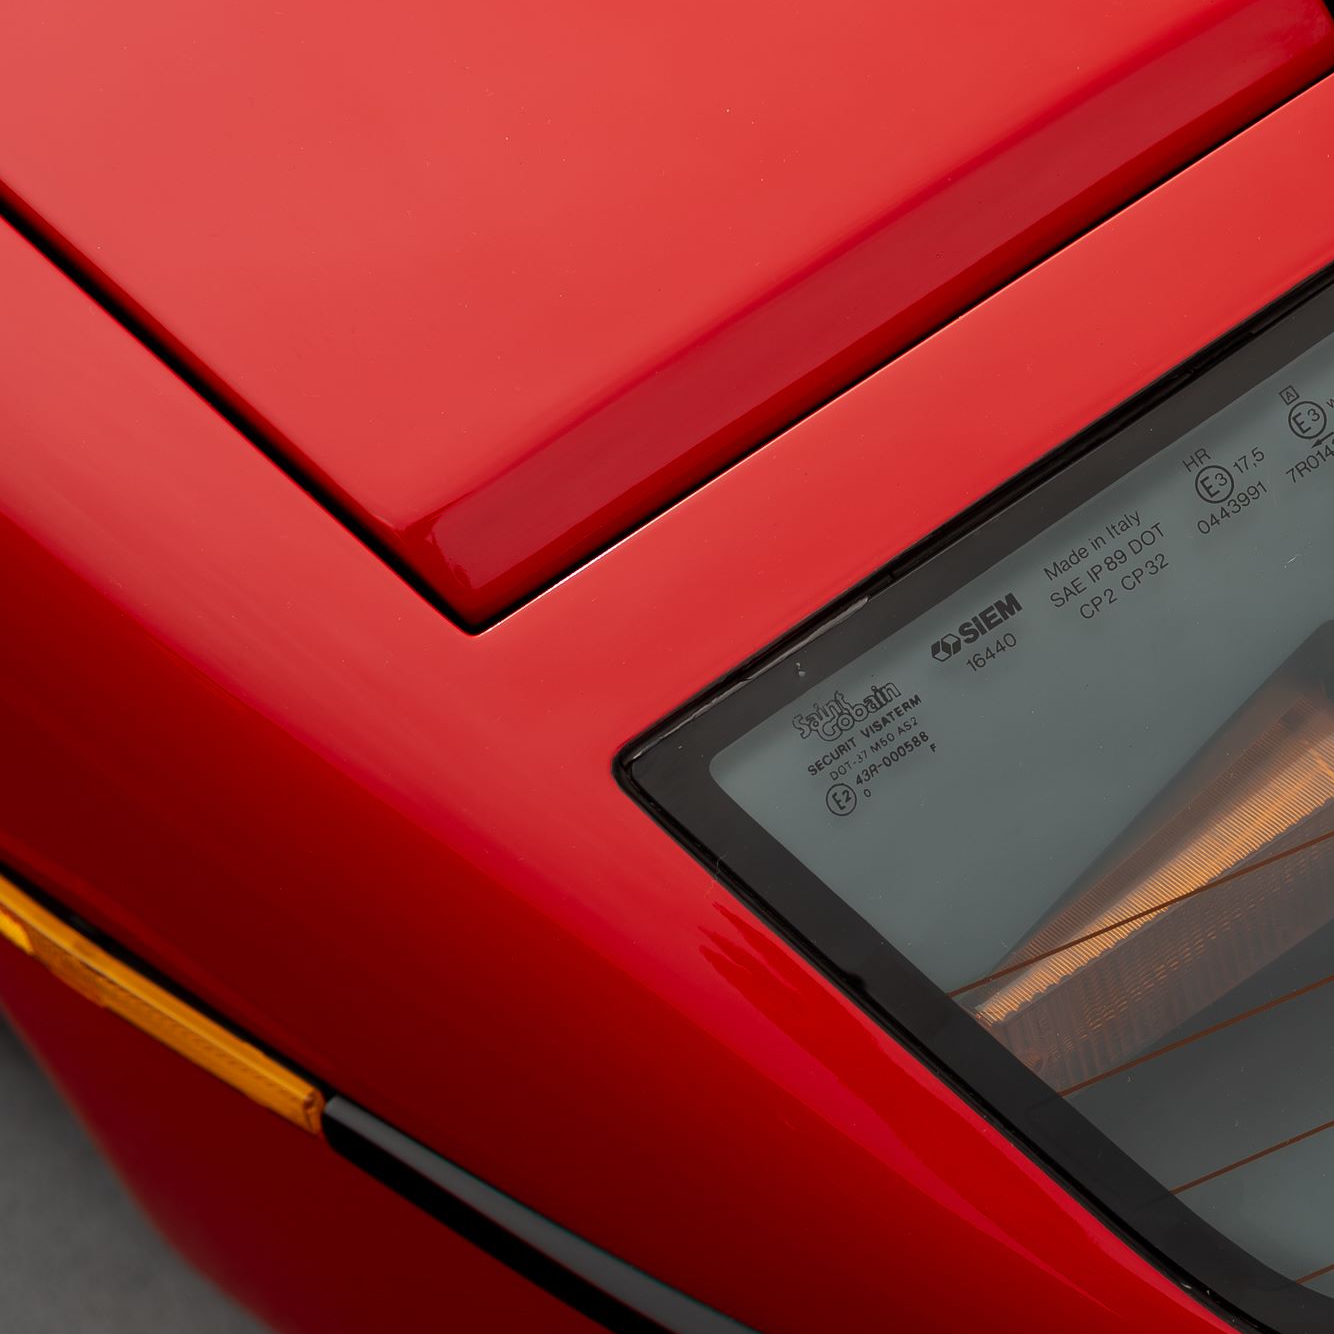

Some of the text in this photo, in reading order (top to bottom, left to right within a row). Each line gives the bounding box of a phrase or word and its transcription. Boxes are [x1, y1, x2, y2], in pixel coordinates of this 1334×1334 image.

[1182, 447, 1212, 473] HR
[1232, 446, 1265, 474] 17,5
[1197, 481, 1267, 534] 0443991
[1043, 511, 1142, 582] Made in Italy
[1050, 577, 1087, 609] SAE
[1127, 522, 1166, 555] DOT
[958, 592, 1023, 644] SIEM
[965, 633, 1017, 672] 16440
[792, 690, 851, 739] Saint
[807, 694, 922, 776] SECURIT VISATERM
[816, 682, 901, 741] Gobain
[855, 731, 929, 785] 43R-000588
